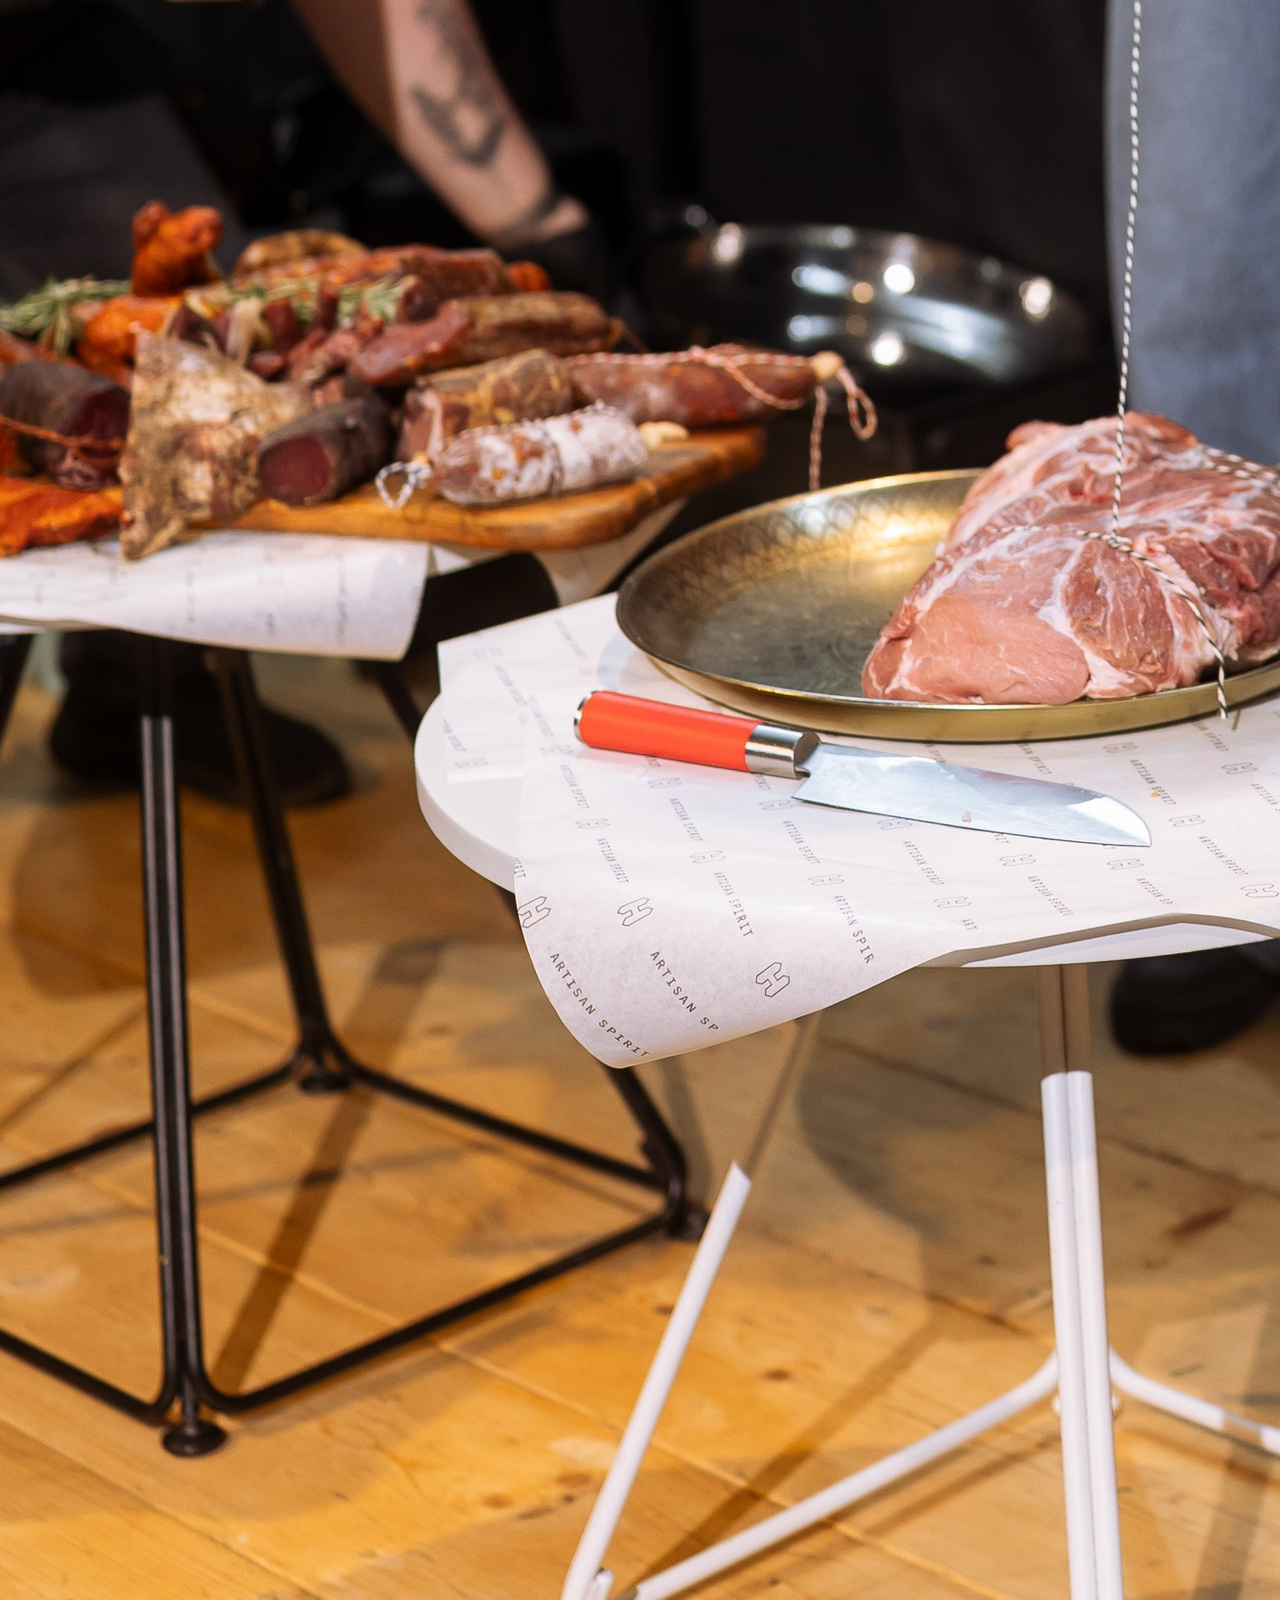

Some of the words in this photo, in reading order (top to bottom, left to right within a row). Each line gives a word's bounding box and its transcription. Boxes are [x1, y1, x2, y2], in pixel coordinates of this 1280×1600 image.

[1130, 759, 1156, 784] ARTISAN
[1152, 785, 1177, 805] SPIRIT
[1251, 783, 1279, 806] ARTISAN
[670, 798, 691, 821] ARTISAN
[683, 822, 703, 842] SPIRIT
[783, 820, 805, 844] ARTISAN
[799, 846, 821, 864] SPIRIT
[596, 838, 617, 862] ARTISAN
[610, 864, 629, 883] SPIRIT
[903, 840, 927, 865] ARTISAN
[921, 867, 945, 885] SPIRIT
[1199, 836, 1226, 858] ARTISAN
[1222, 859, 1248, 876] SPIRIT
[714, 872, 735, 896] ARTISAN
[729, 898, 754, 936] SPIRIT
[833, 895, 859, 926] ARTISAN
[1027, 875, 1054, 897] ARTISAN
[1048, 897, 1074, 917] SPIRIT
[1136, 878, 1164, 899] ARTISAN
[962, 918, 978, 932] ART
[550, 953, 596, 1015] ARTISAN
[598, 1019, 651, 1057] SPIRIT
[650, 951, 697, 1013] ARTISAN
[700, 1016, 719, 1032] SP
